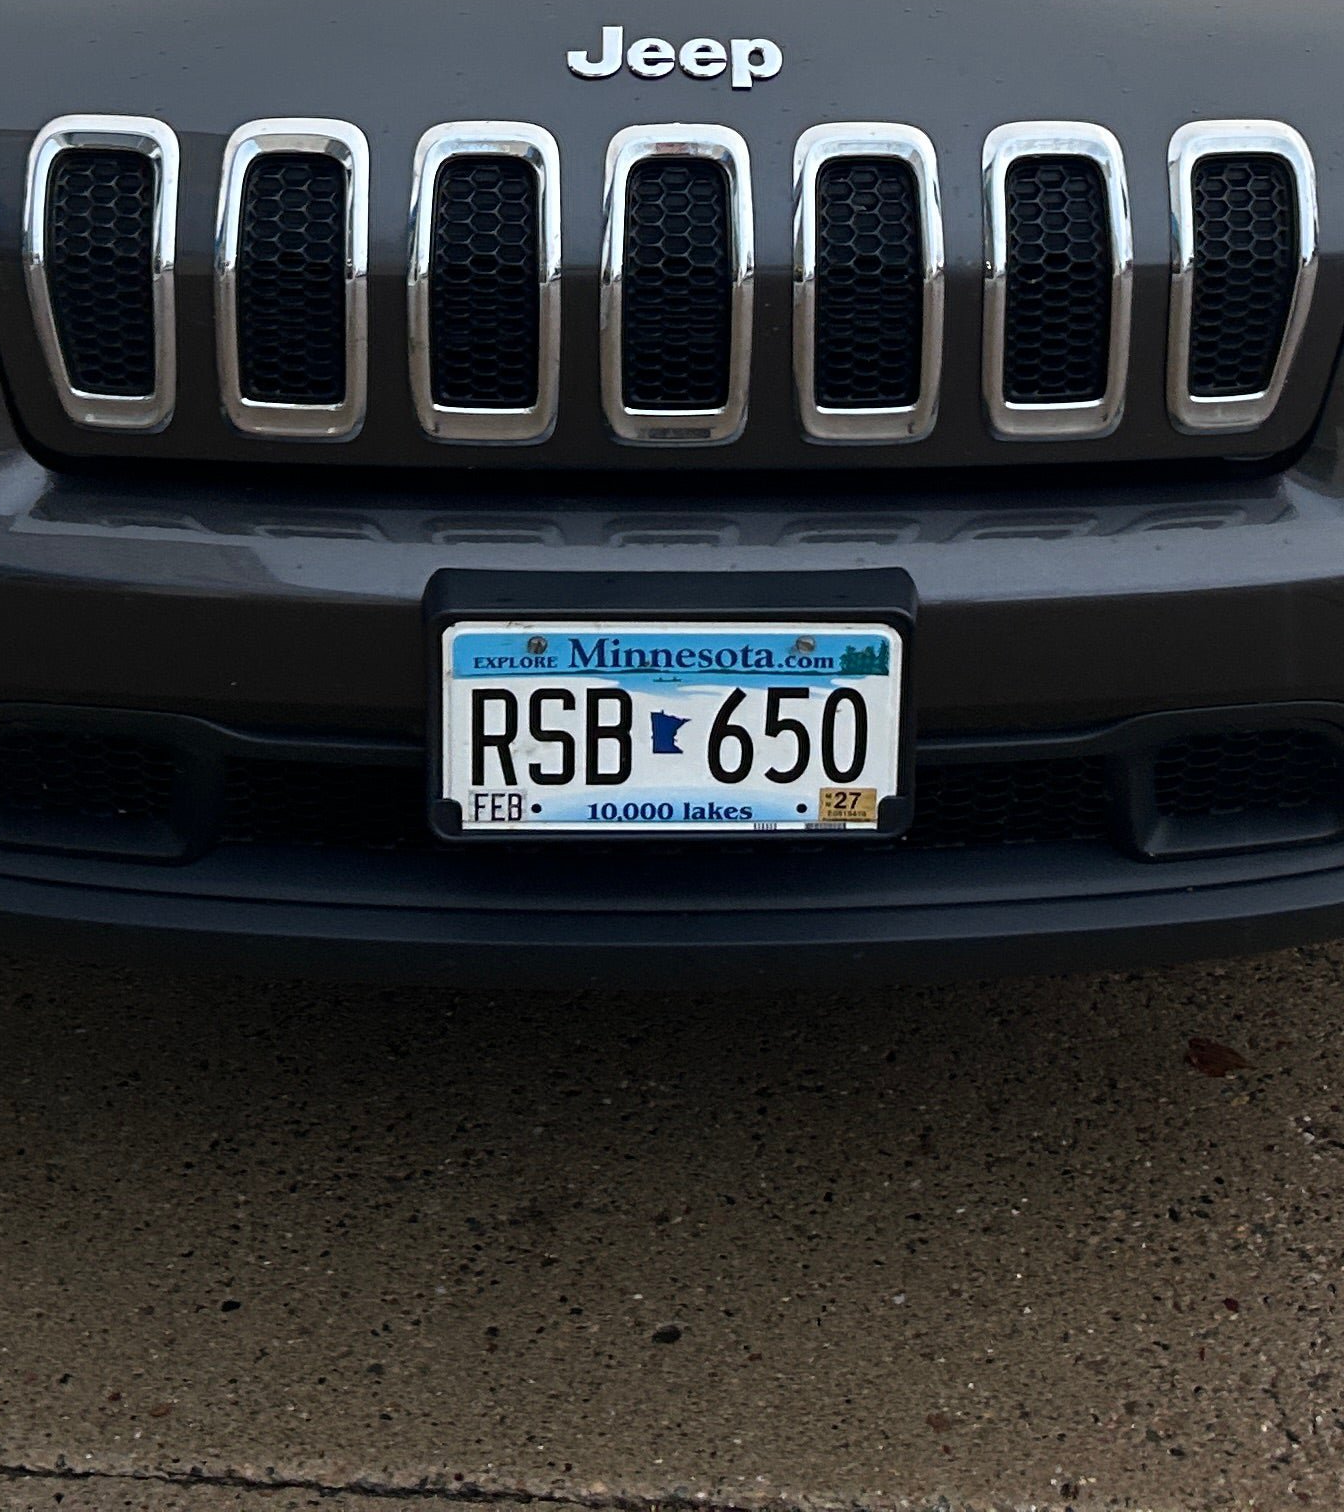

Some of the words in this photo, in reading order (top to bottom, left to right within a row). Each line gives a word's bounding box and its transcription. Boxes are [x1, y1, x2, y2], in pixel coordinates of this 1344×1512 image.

[567, 26, 783, 90] Jeep
[472, 656, 558, 669] EXPLORE
[472, 688, 633, 785] RSB
[707, 687, 868, 784] 650
[474, 793, 523, 821] FEB
[587, 802, 674, 821] 10,000
[683, 801, 753, 821] lakes
[834, 791, 862, 809] 27
